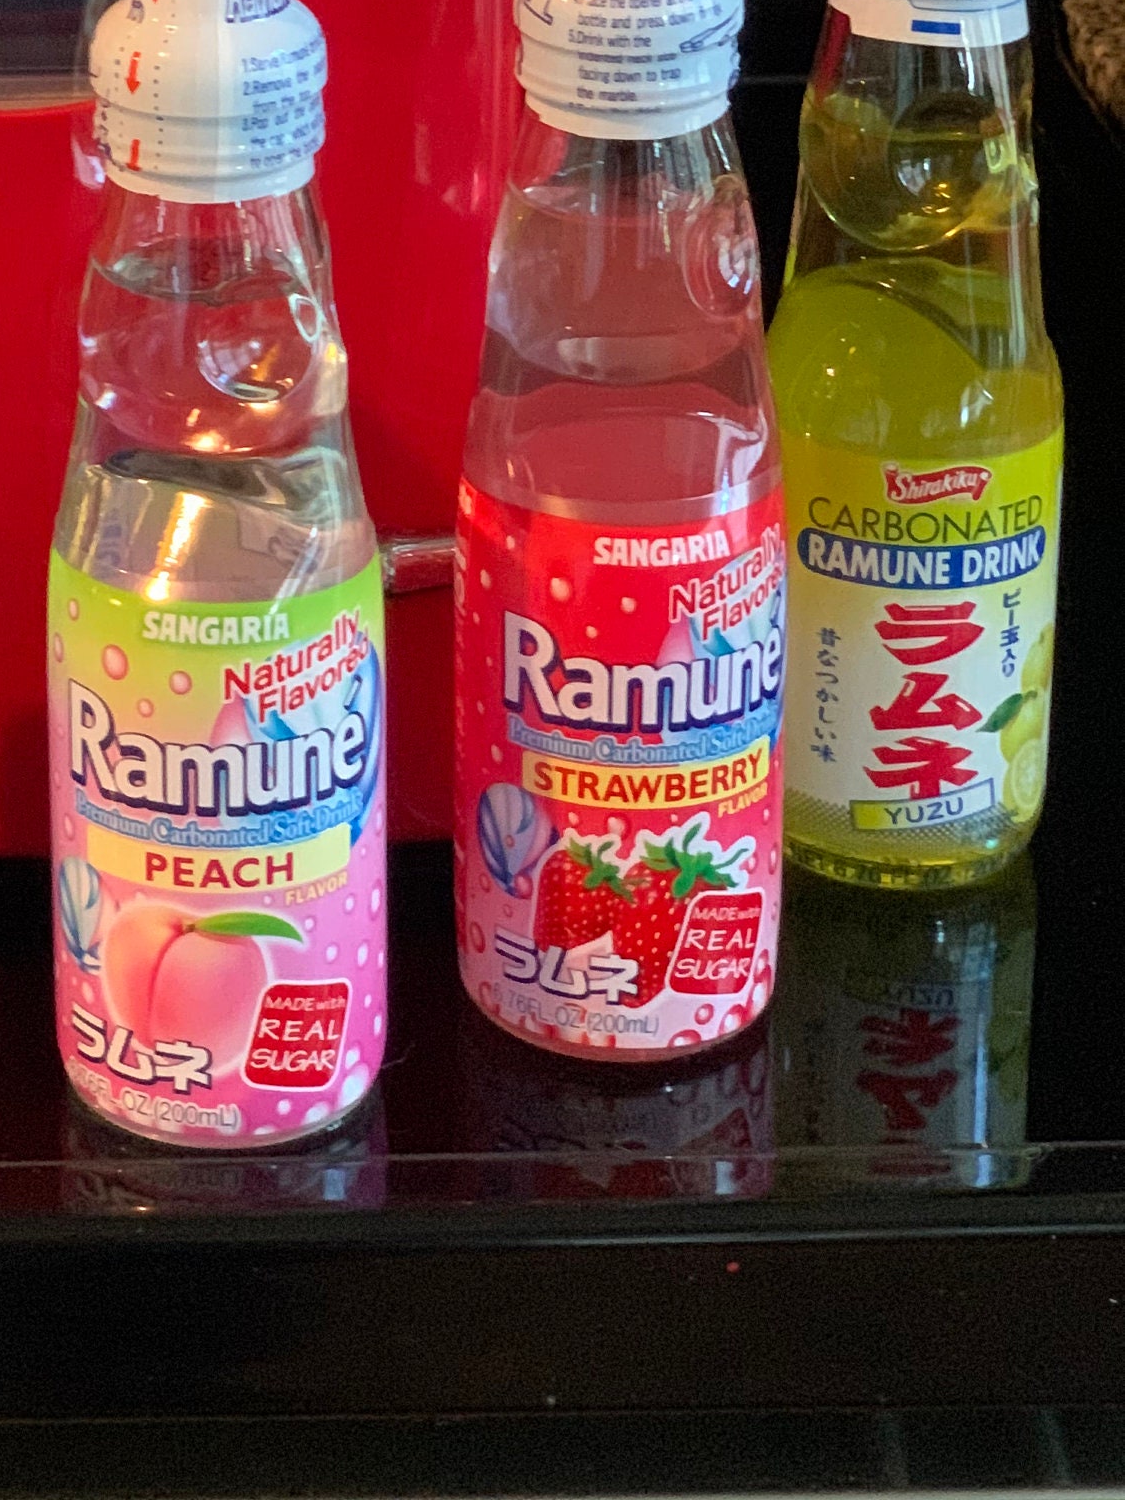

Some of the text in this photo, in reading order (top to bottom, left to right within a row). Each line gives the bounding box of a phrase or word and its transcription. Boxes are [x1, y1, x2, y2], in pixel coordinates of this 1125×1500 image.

[893, 469, 979, 501] Shirakiku
[807, 494, 1043, 545] CARBONATED
[592, 530, 731, 568] SANGARIA
[807, 529, 1042, 585] RAMUNE DRINK
[701, 564, 784, 642] Flavore
[142, 610, 291, 646] SANGARIA
[224, 609, 361, 700] Naturally
[257, 627, 370, 723] Flavored
[810, 626, 842, 764] 昔なつかしい味
[862, 601, 986, 801] ラムネ
[508, 713, 592, 759] Premium
[593, 734, 708, 765] Carbonated
[533, 748, 764, 804] STRAWBERRY
[76, 790, 150, 839] Premium
[152, 818, 271, 848] Carbonated
[717, 782, 769, 819] FLAVOR
[883, 797, 965, 825] YUZU
[144, 851, 295, 890] PEACH
[284, 871, 349, 907] FLAVOR
[691, 905, 737, 921] MADE
[683, 926, 756, 951] REAL
[494, 925, 640, 1007] ラムネ
[674, 957, 751, 982] SUGAR
[263, 995, 315, 1012] MADE
[257, 1017, 342, 1042] REAL
[586, 1012, 660, 1037] (200mL)
[71, 1001, 213, 1095] ラムネ
[249, 1046, 336, 1073] SUGAR
[154, 1099, 241, 1130] (200mL)
